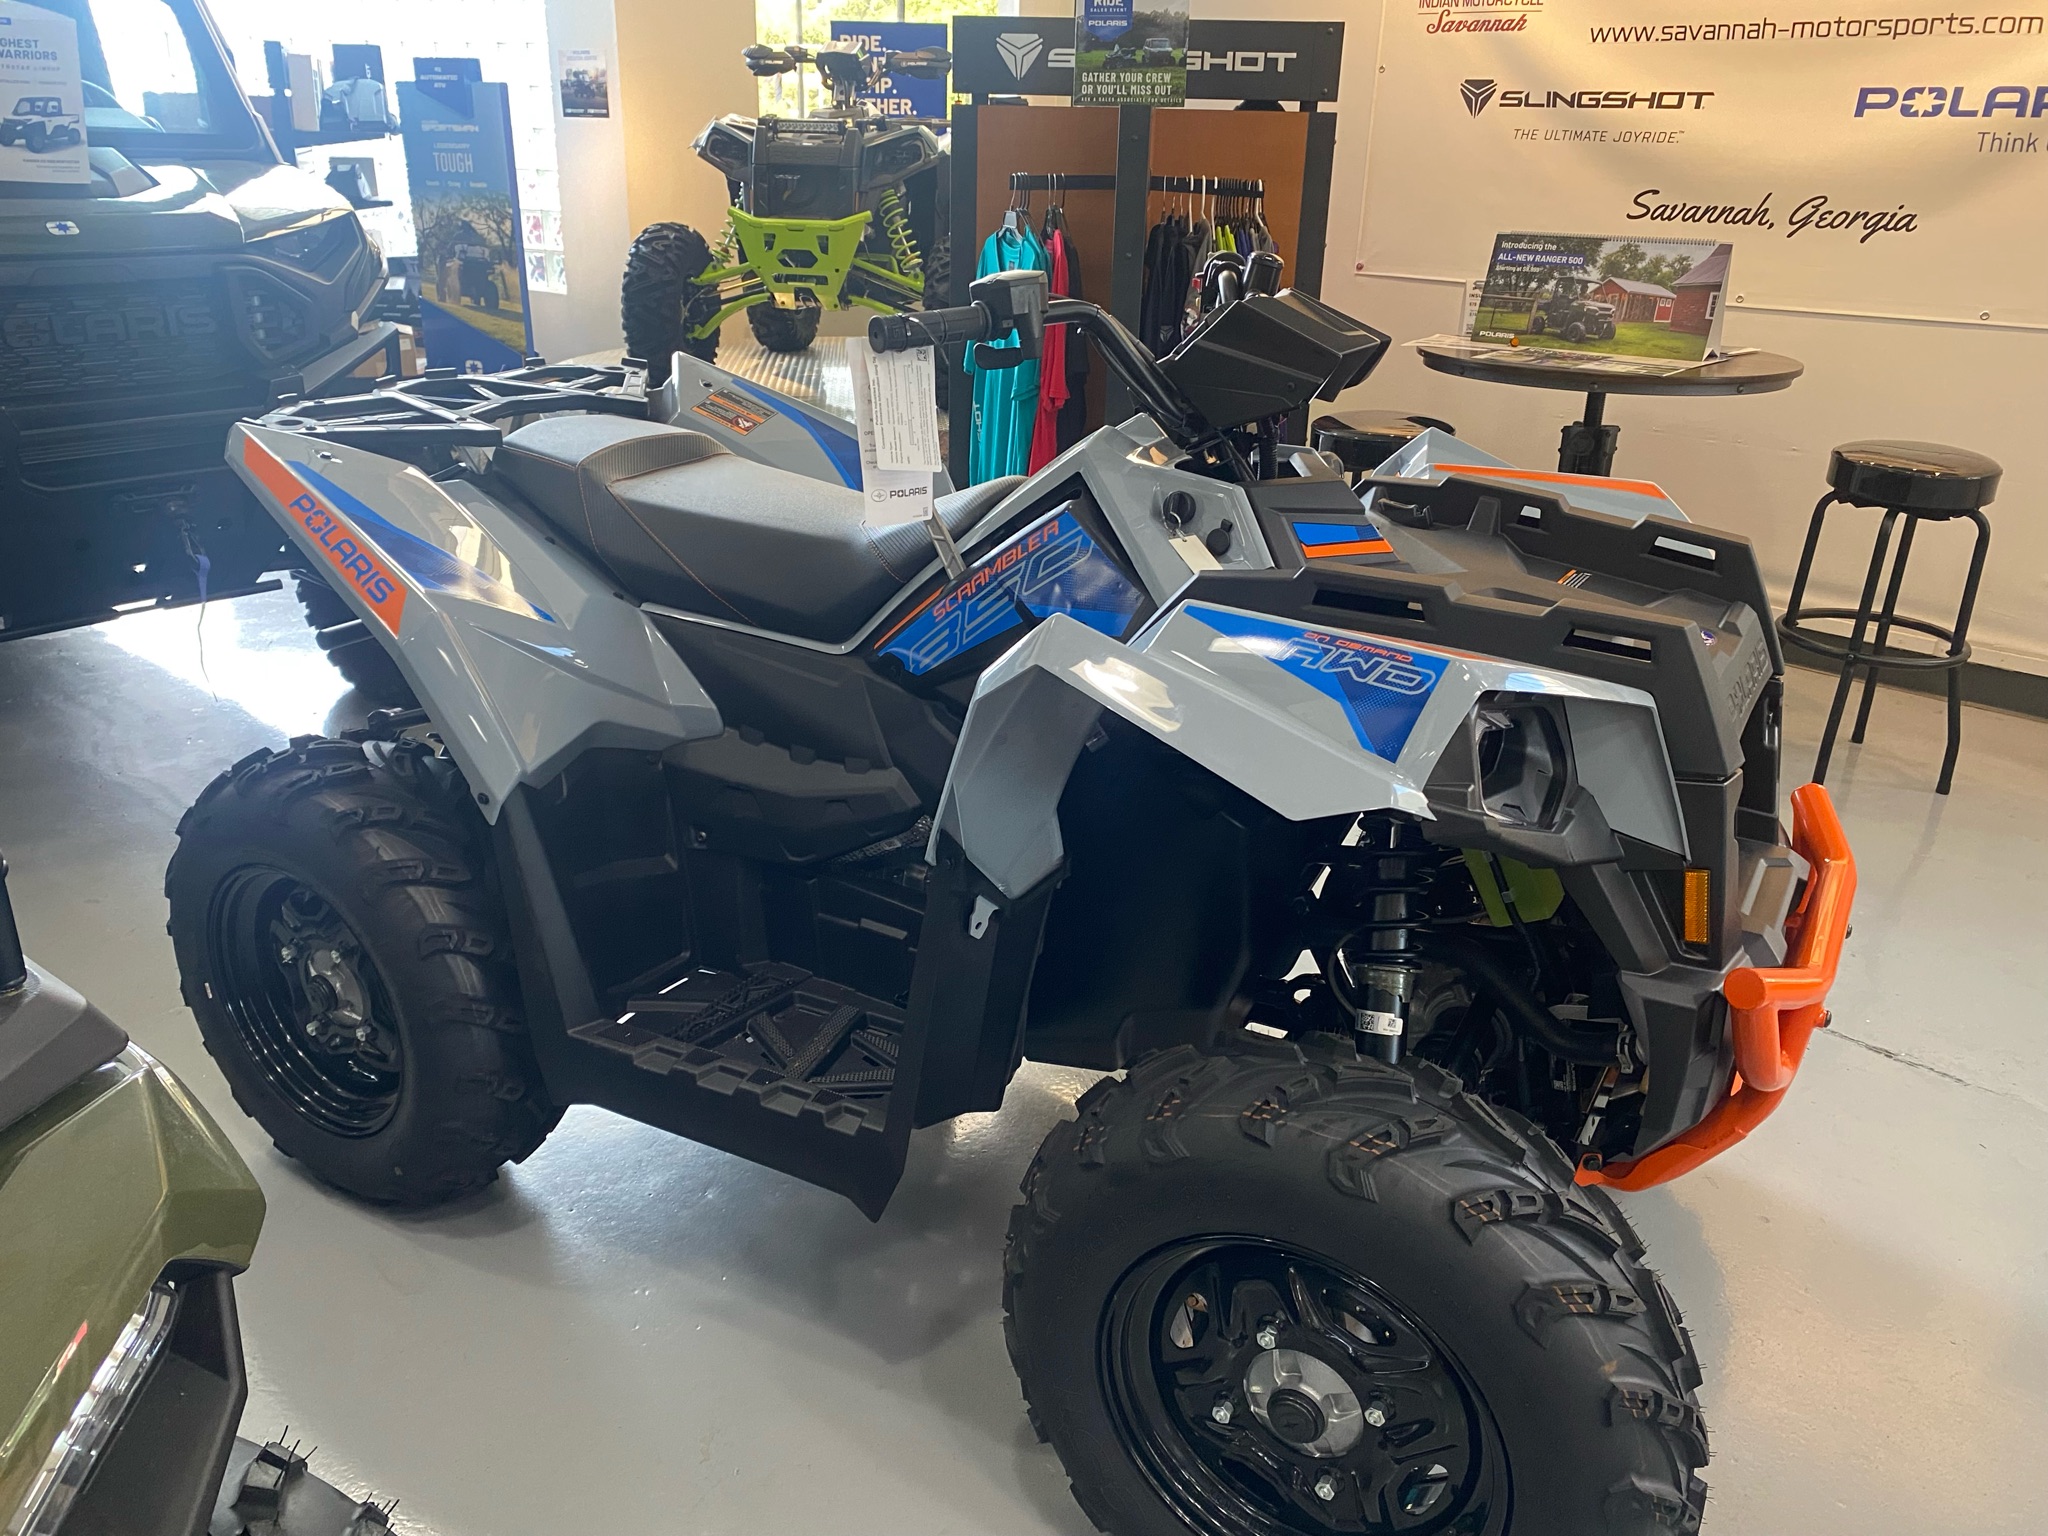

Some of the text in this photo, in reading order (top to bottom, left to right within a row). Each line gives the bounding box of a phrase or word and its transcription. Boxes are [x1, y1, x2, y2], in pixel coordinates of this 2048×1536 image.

[1426, 9, 1528, 34] Savannah
[1590, 13, 2044, 43] www.savannah-motorsports.com
[1081, 72, 1172, 83] GATHER YOUR CREW
[1081, 84, 1172, 96] OR YOU'LL MISS OUT
[1499, 90, 1715, 110] SLINGSHOT
[1513, 128, 1540, 141] THE
[1543, 129, 1609, 143] ULTIMATE
[1977, 132, 2040, 153] Think
[432, 152, 474, 173] TOUGH
[1625, 188, 1919, 245] Savannah, Georgia
[1501, 241, 1557, 251] Introducing the
[1497, 252, 1584, 265] ALL-NEW RANGER 500
[1479, 330, 1515, 339] POLARIS
[889, 486, 928, 500] POLARIS
[289, 493, 396, 605] POLARIS
[932, 520, 1060, 623] SCRAMBLER
[1280, 636, 1437, 695] AWD
